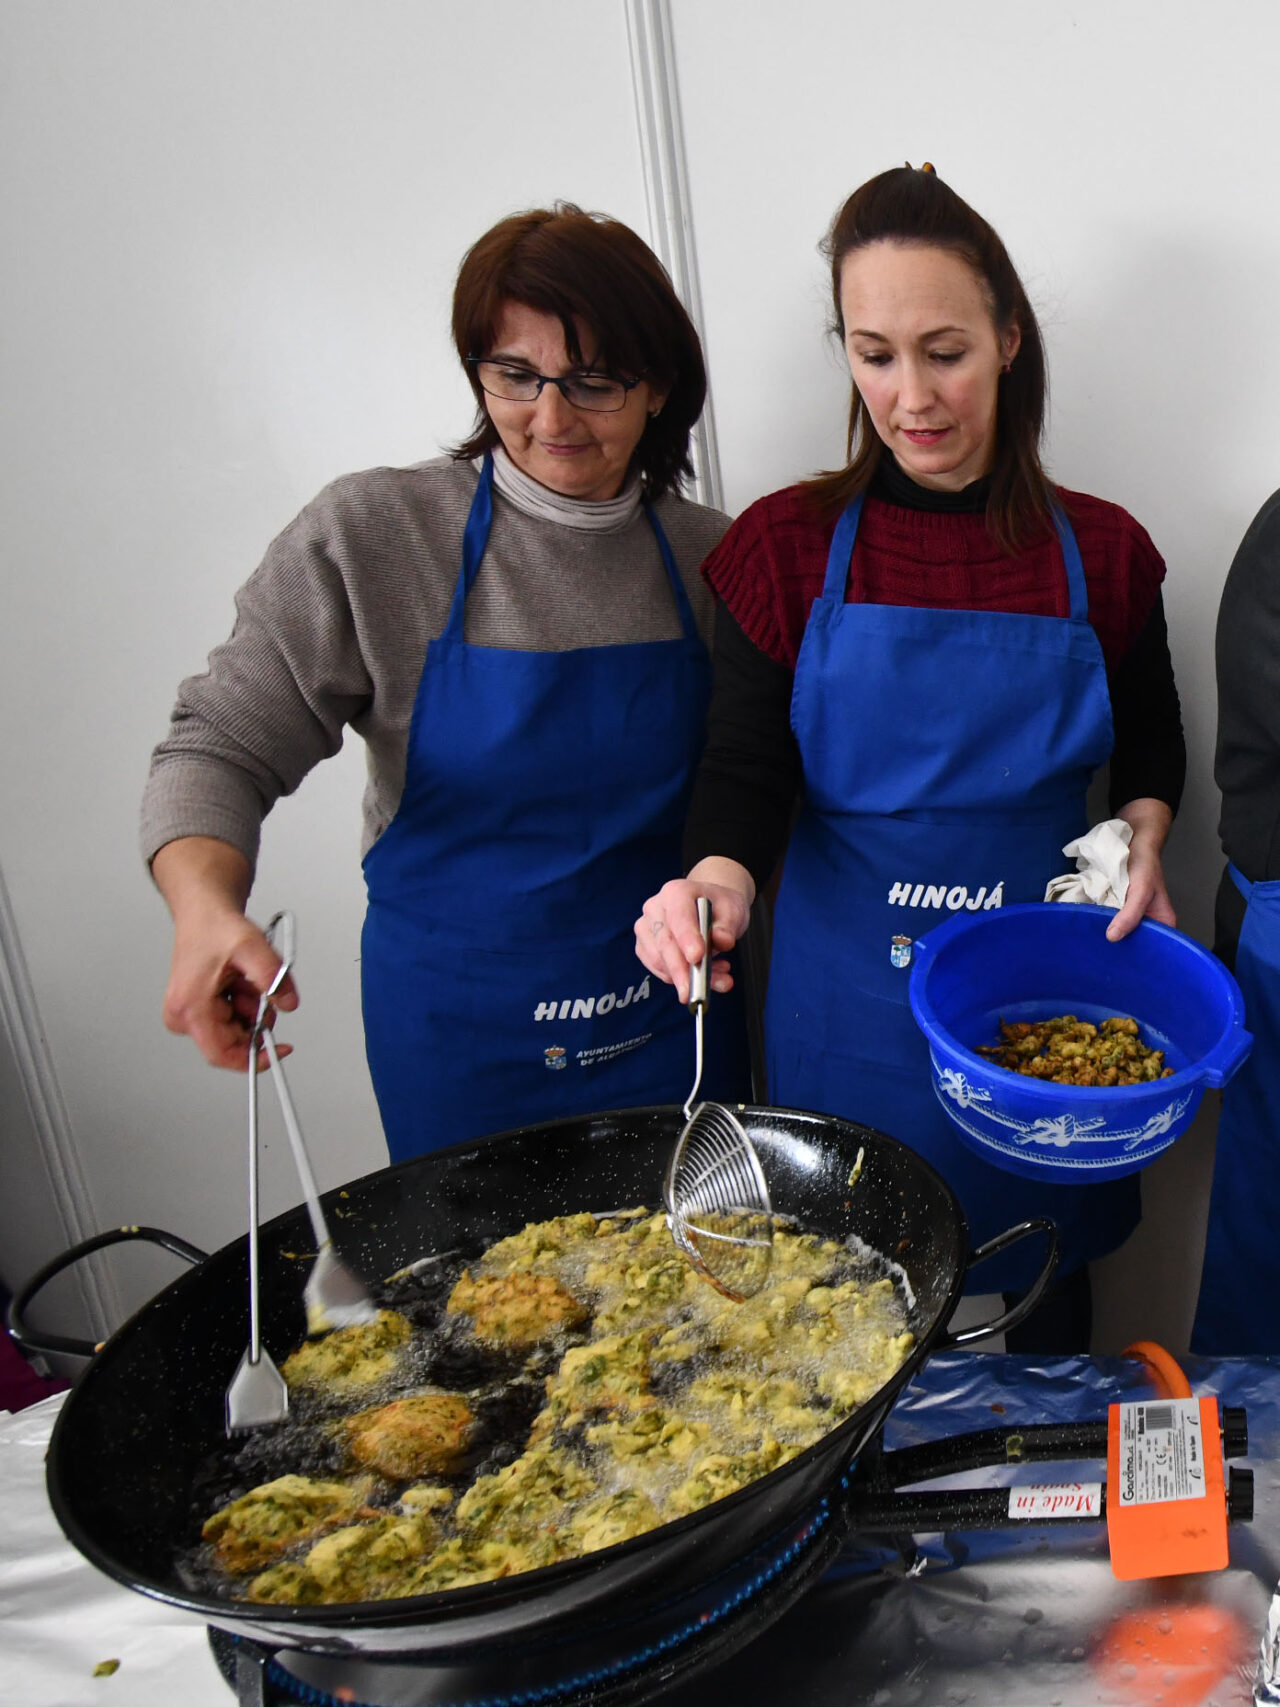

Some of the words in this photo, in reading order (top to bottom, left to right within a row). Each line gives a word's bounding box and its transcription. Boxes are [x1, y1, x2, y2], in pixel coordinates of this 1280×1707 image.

[888, 881, 1004, 910] HINOJÁ
[534, 975, 650, 1021] HINOJÁ
[1017, 1496, 1035, 1513] in
[1043, 1494, 1095, 1512] Made
